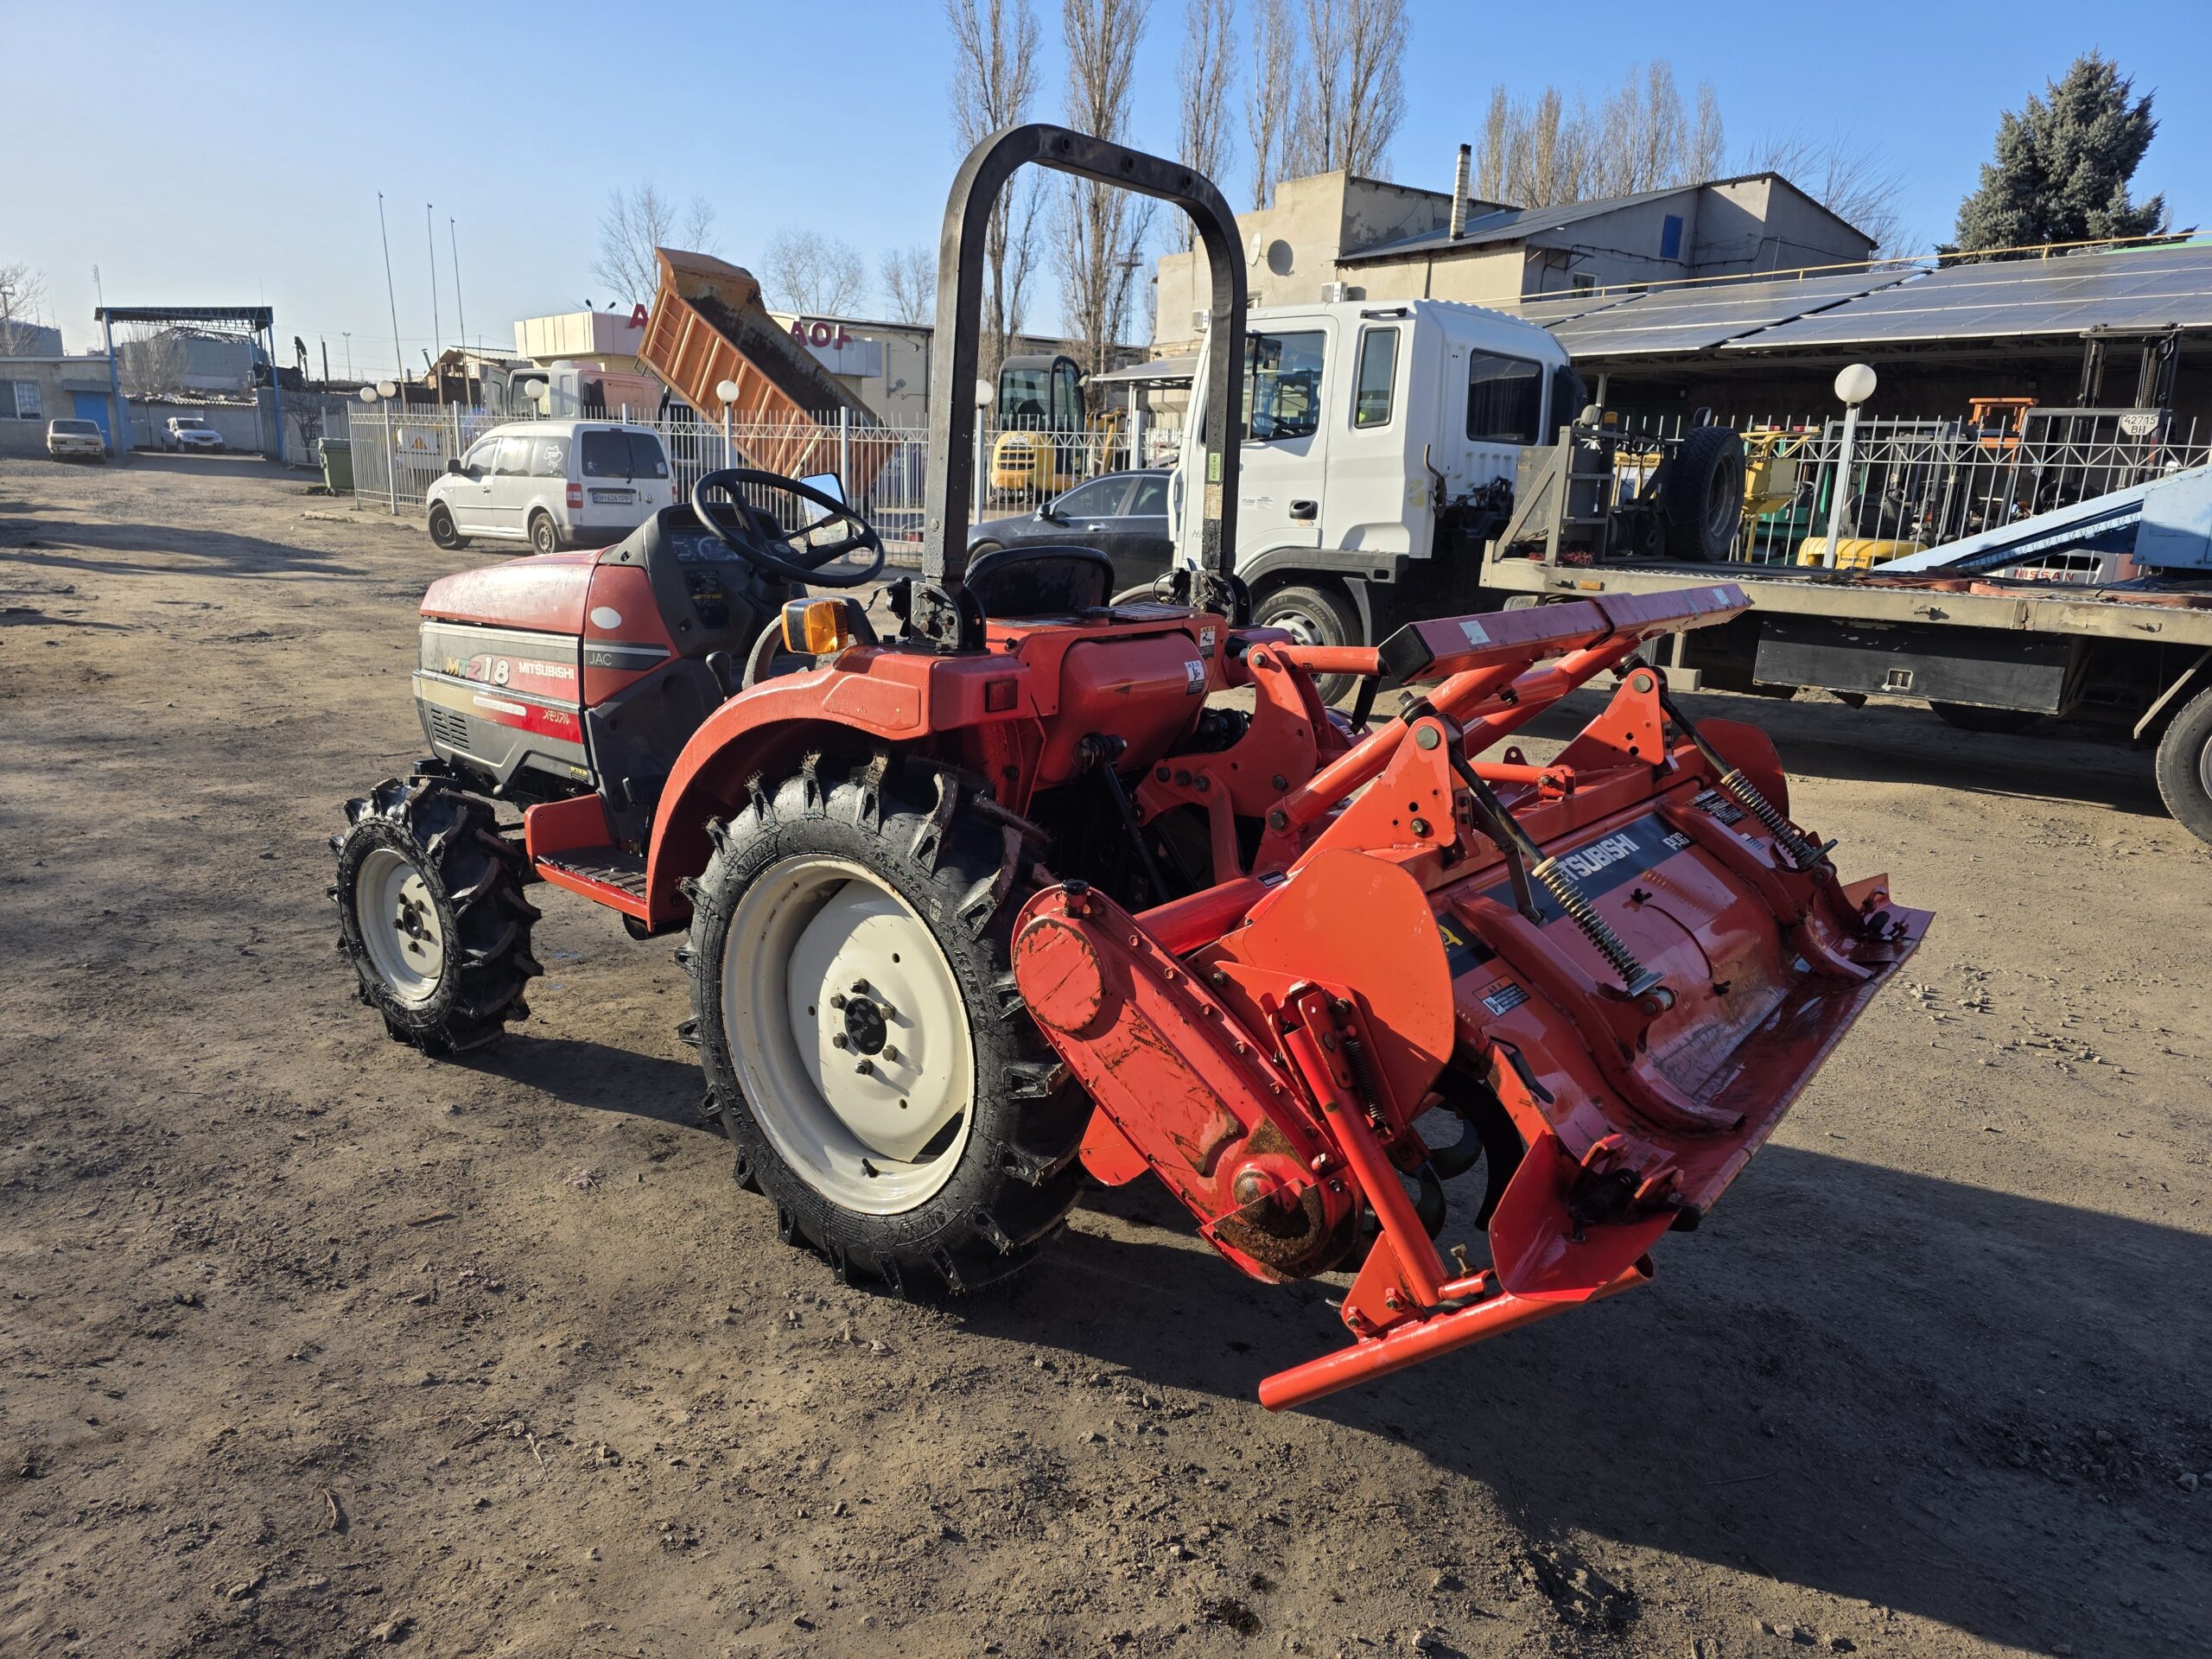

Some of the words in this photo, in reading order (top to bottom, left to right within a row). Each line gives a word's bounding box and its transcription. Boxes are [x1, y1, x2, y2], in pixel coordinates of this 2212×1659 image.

[2125, 416, 2156, 424] 42715
[2131, 425, 2146, 434] BH
[2013, 569, 2075, 582] NISSAN
[589, 652, 613, 666] JAC
[518, 662, 575, 680] MITSUBISHI
[543, 709, 570, 725] メモリアル
[1556, 833, 1641, 881] TSUBISHI
